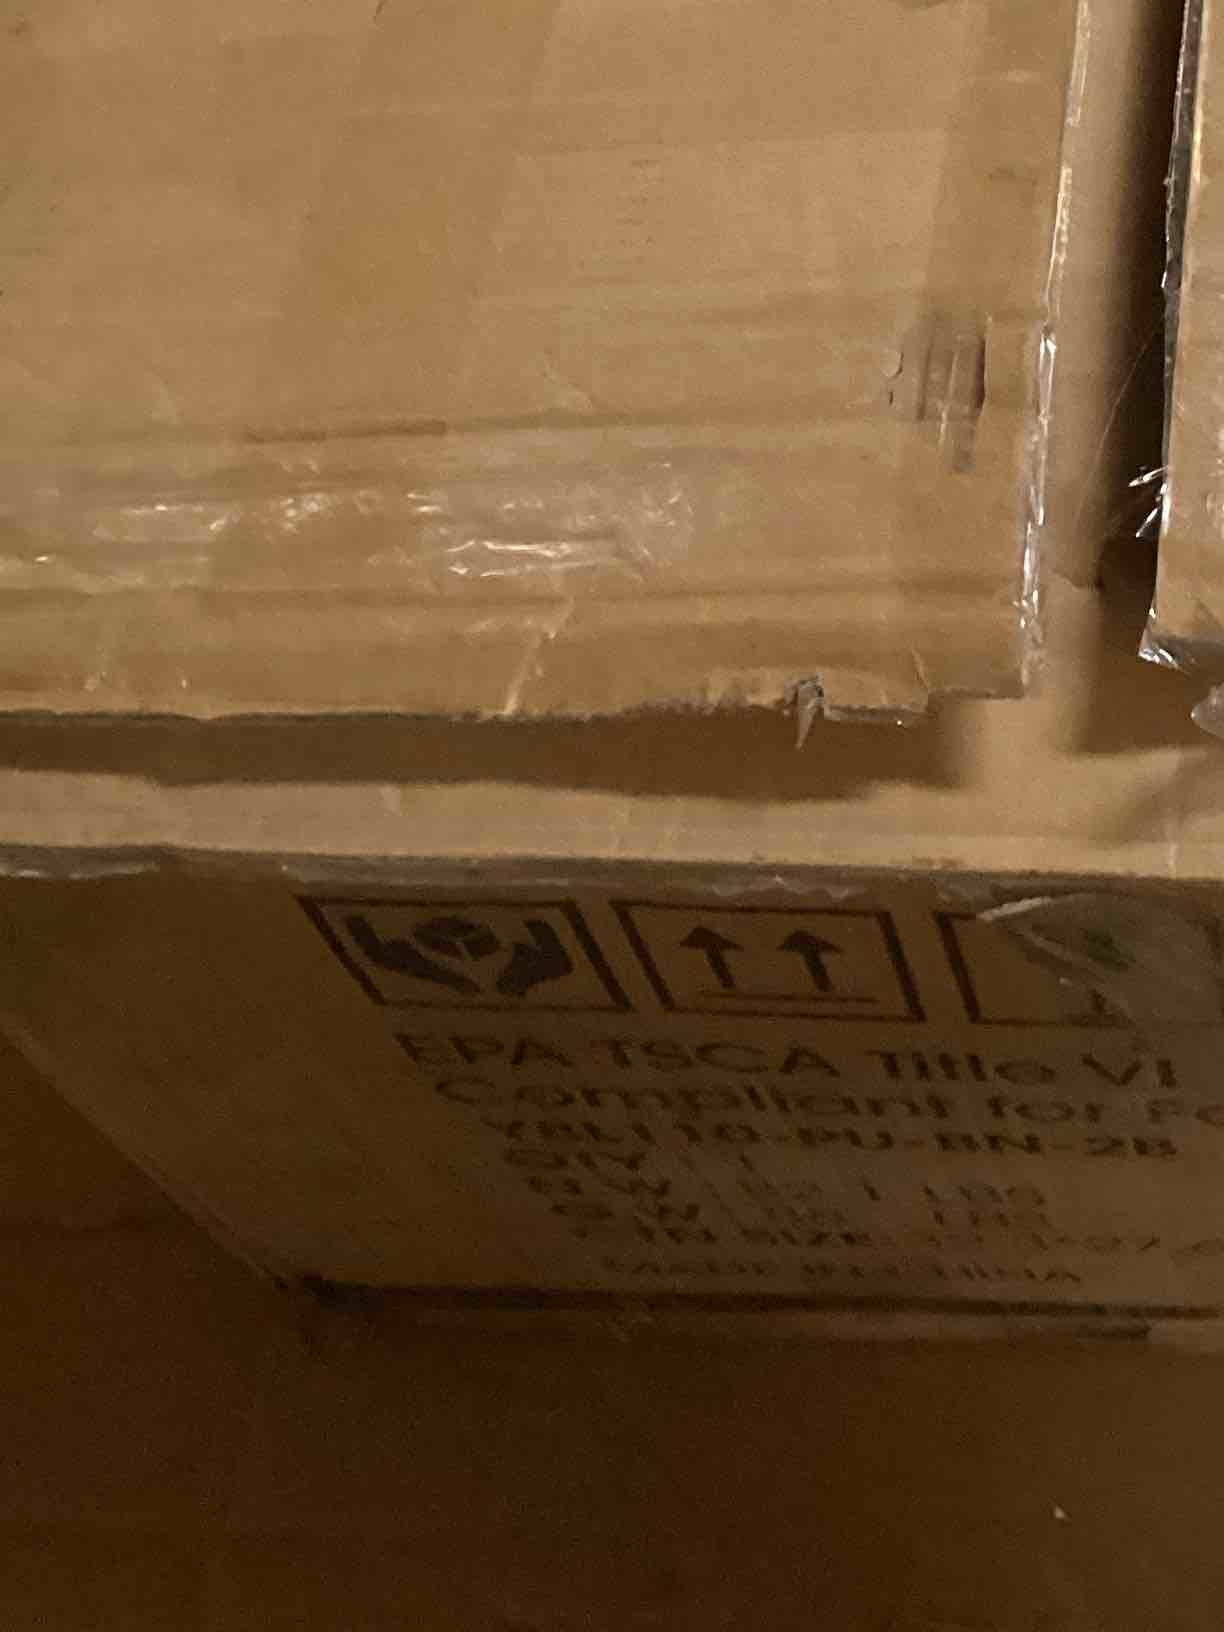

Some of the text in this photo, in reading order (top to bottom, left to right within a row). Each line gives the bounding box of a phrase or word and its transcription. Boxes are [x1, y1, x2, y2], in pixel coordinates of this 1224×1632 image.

[392, 1032, 1177, 1088] EPA TSCA Title VI
[435, 1077, 949, 1120] Compliant
[985, 1098, 1102, 1125] for
